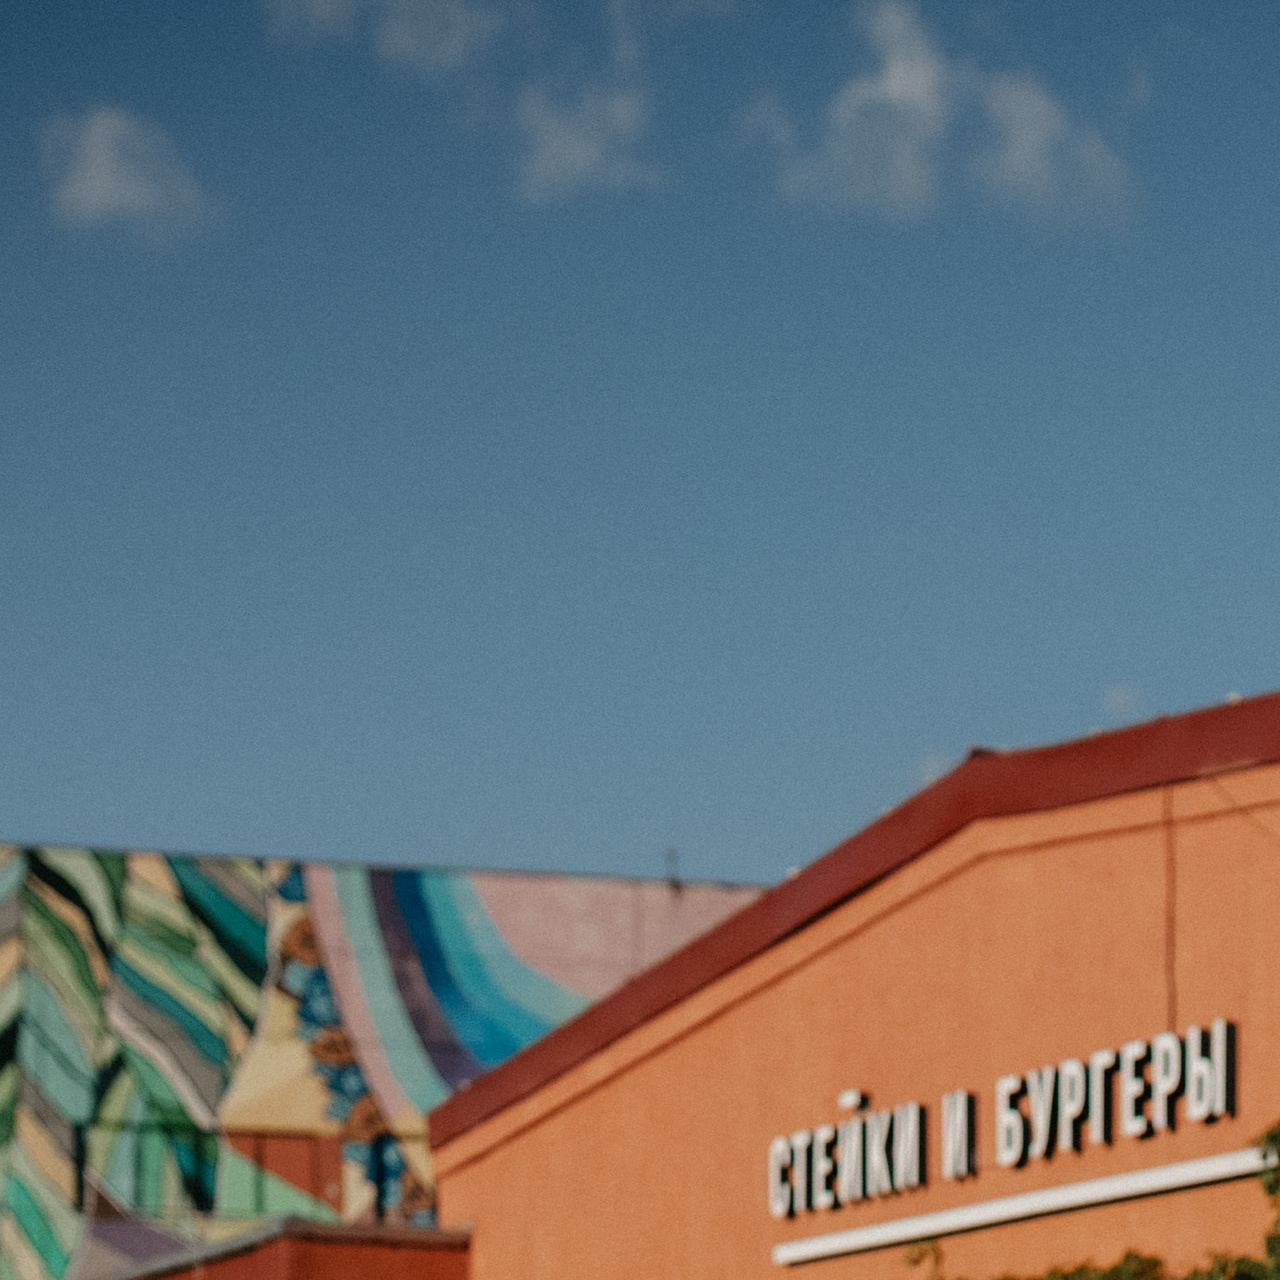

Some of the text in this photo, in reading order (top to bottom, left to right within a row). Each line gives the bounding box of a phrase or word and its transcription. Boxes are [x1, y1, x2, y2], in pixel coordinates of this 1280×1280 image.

[768, 1017, 1228, 1218] СТЕЙКИ И БУРГЕРЫ
